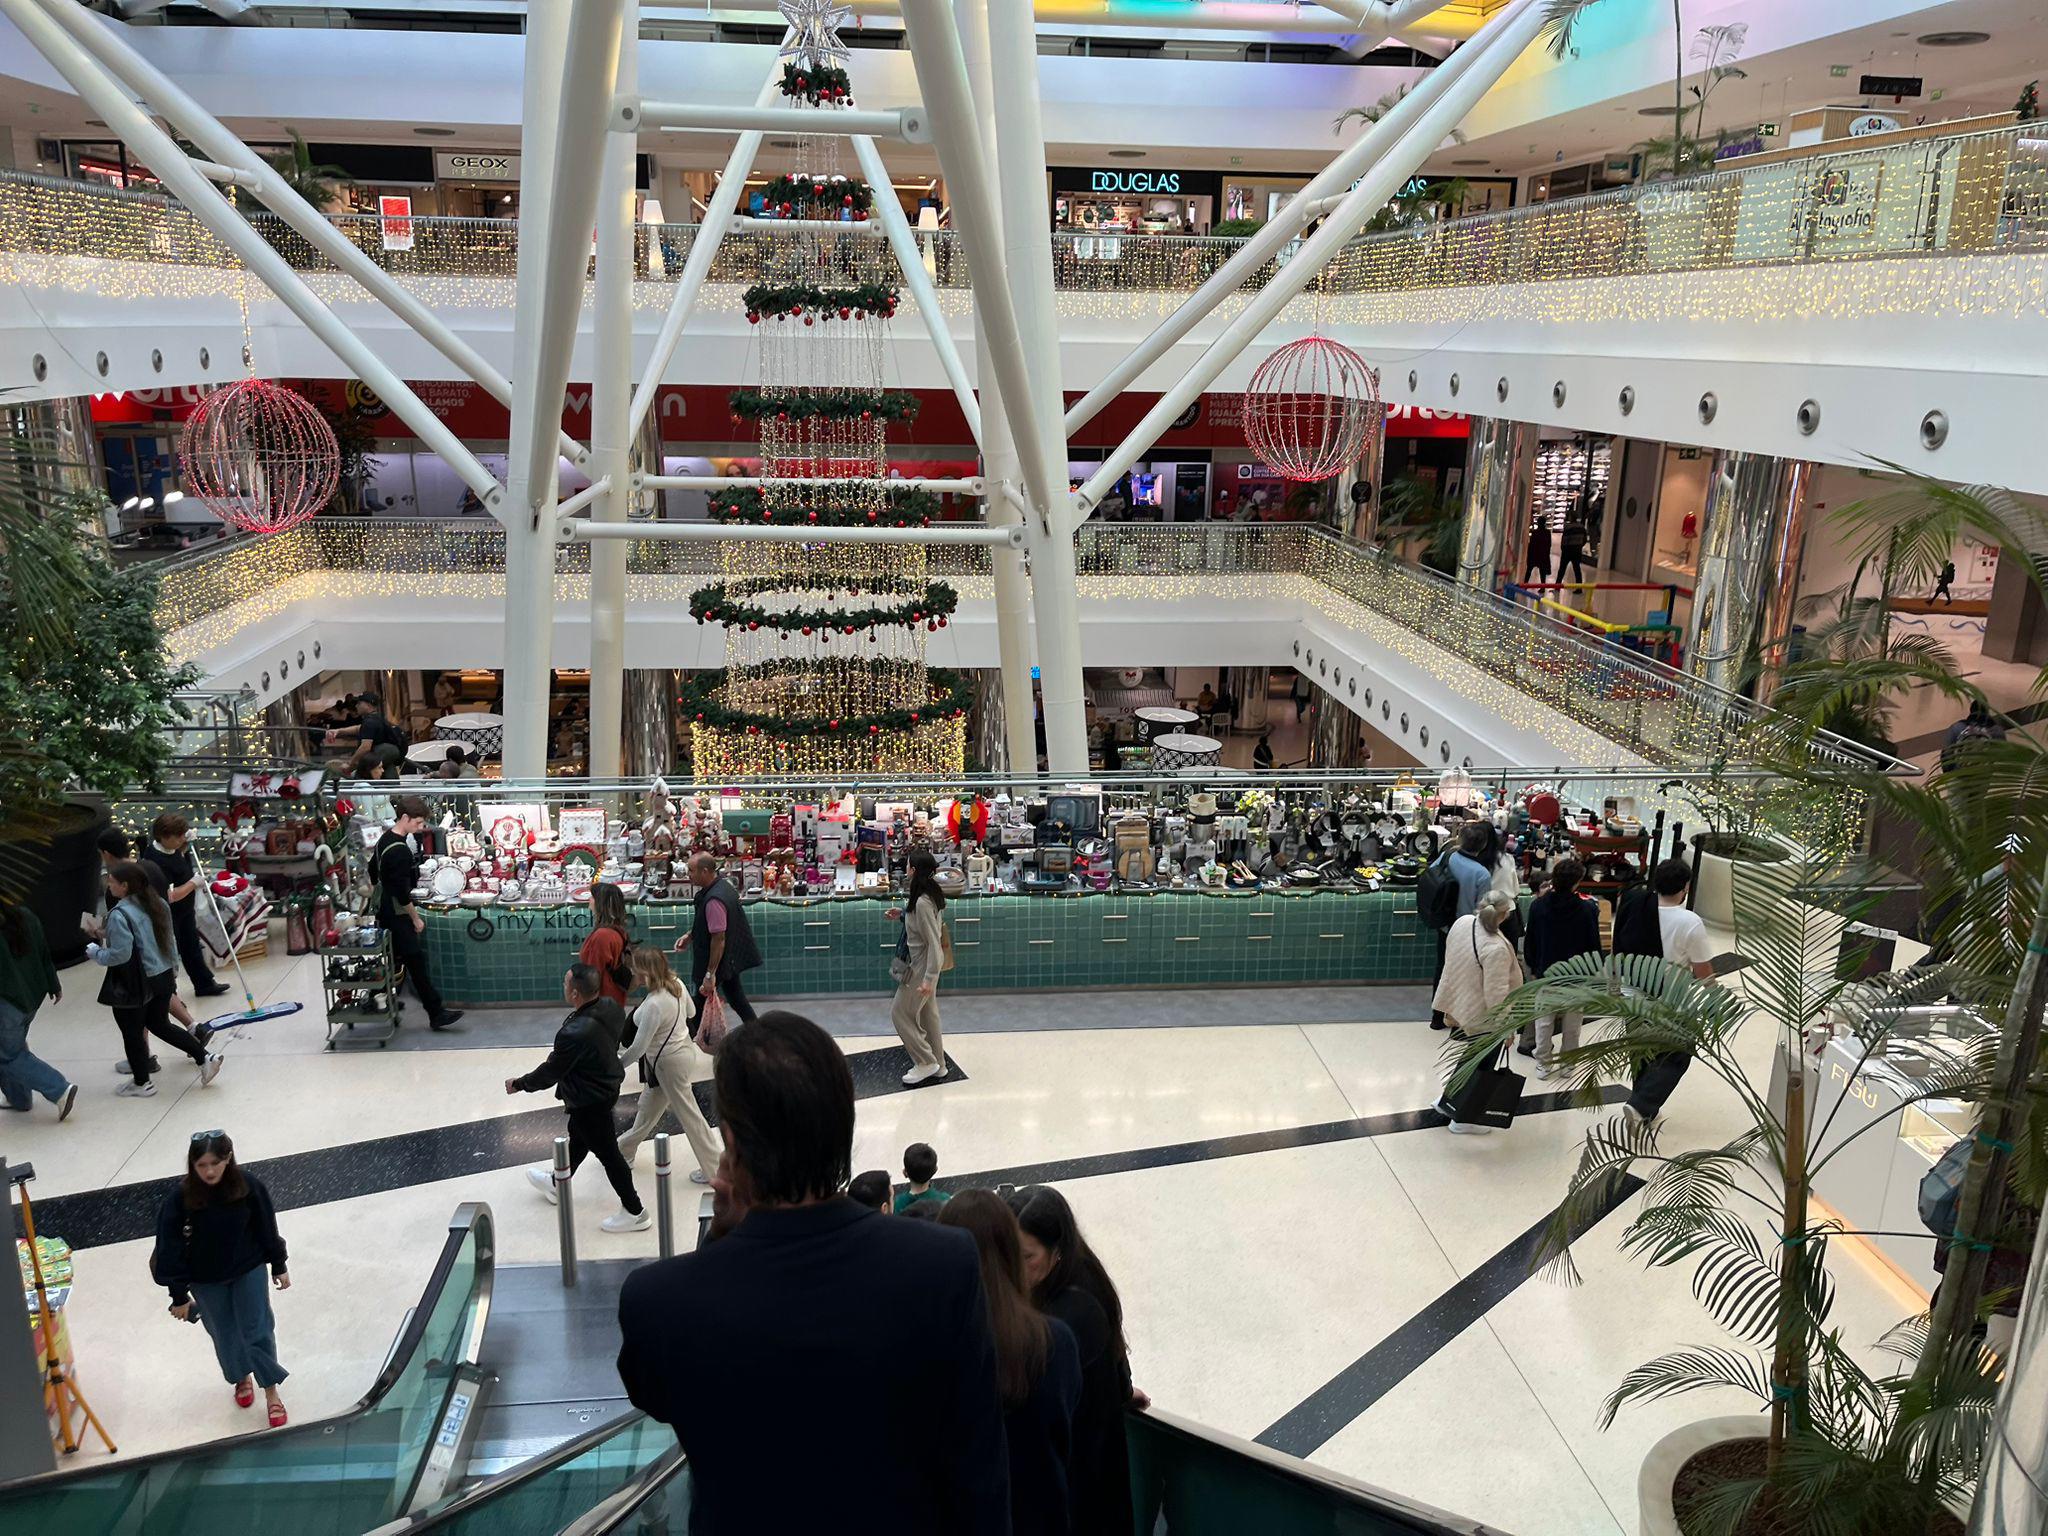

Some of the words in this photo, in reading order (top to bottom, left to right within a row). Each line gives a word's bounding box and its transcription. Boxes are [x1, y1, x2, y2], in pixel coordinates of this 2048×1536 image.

[451, 156, 508, 168] GEOX
[1092, 171, 1180, 193] DOUGLAS
[497, 912, 535, 935] my
